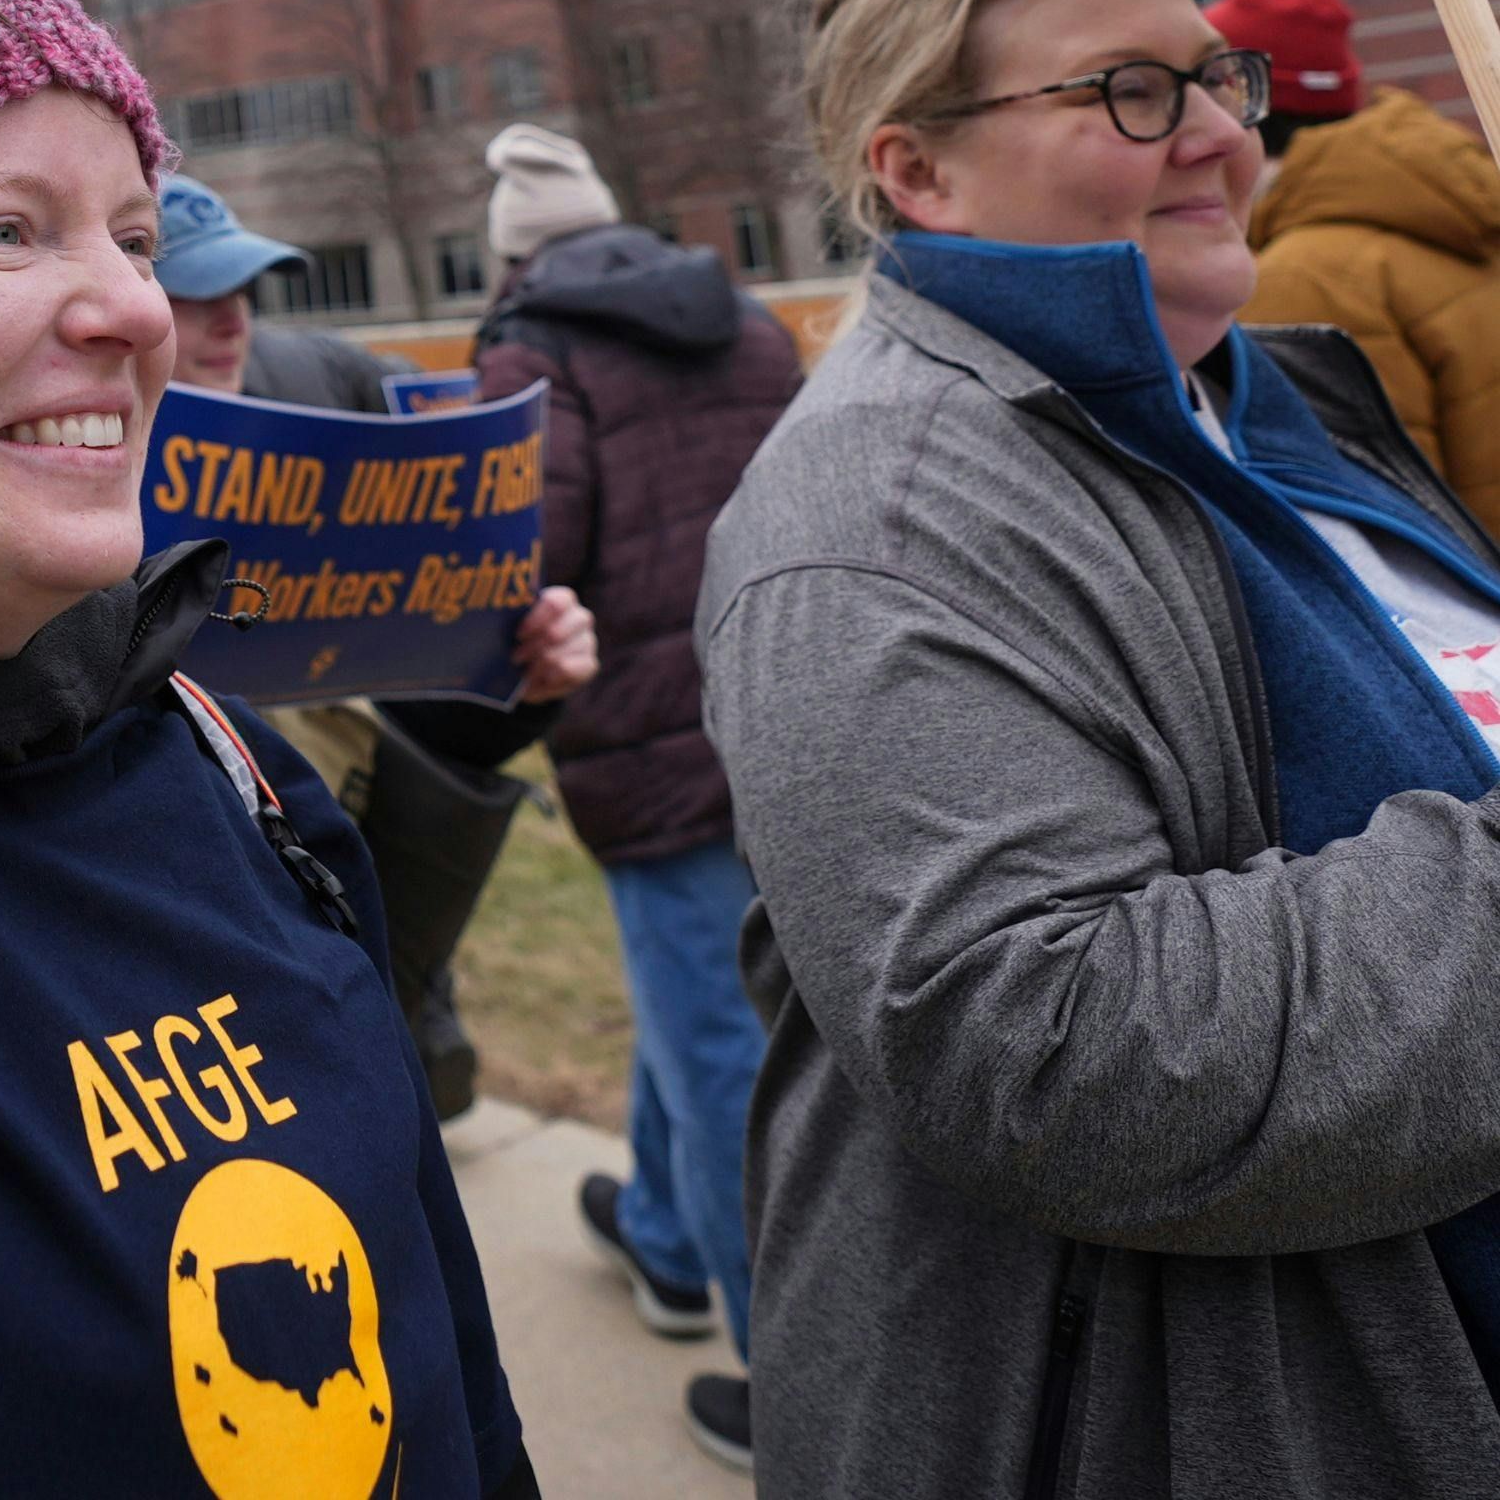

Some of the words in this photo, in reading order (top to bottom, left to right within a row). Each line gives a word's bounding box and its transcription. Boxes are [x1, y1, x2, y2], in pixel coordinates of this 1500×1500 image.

[153, 435, 326, 536] STAND,
[338, 453, 466, 531] UNITE,
[228, 558, 404, 624] Workers
[66, 993, 298, 1193] AFGE
